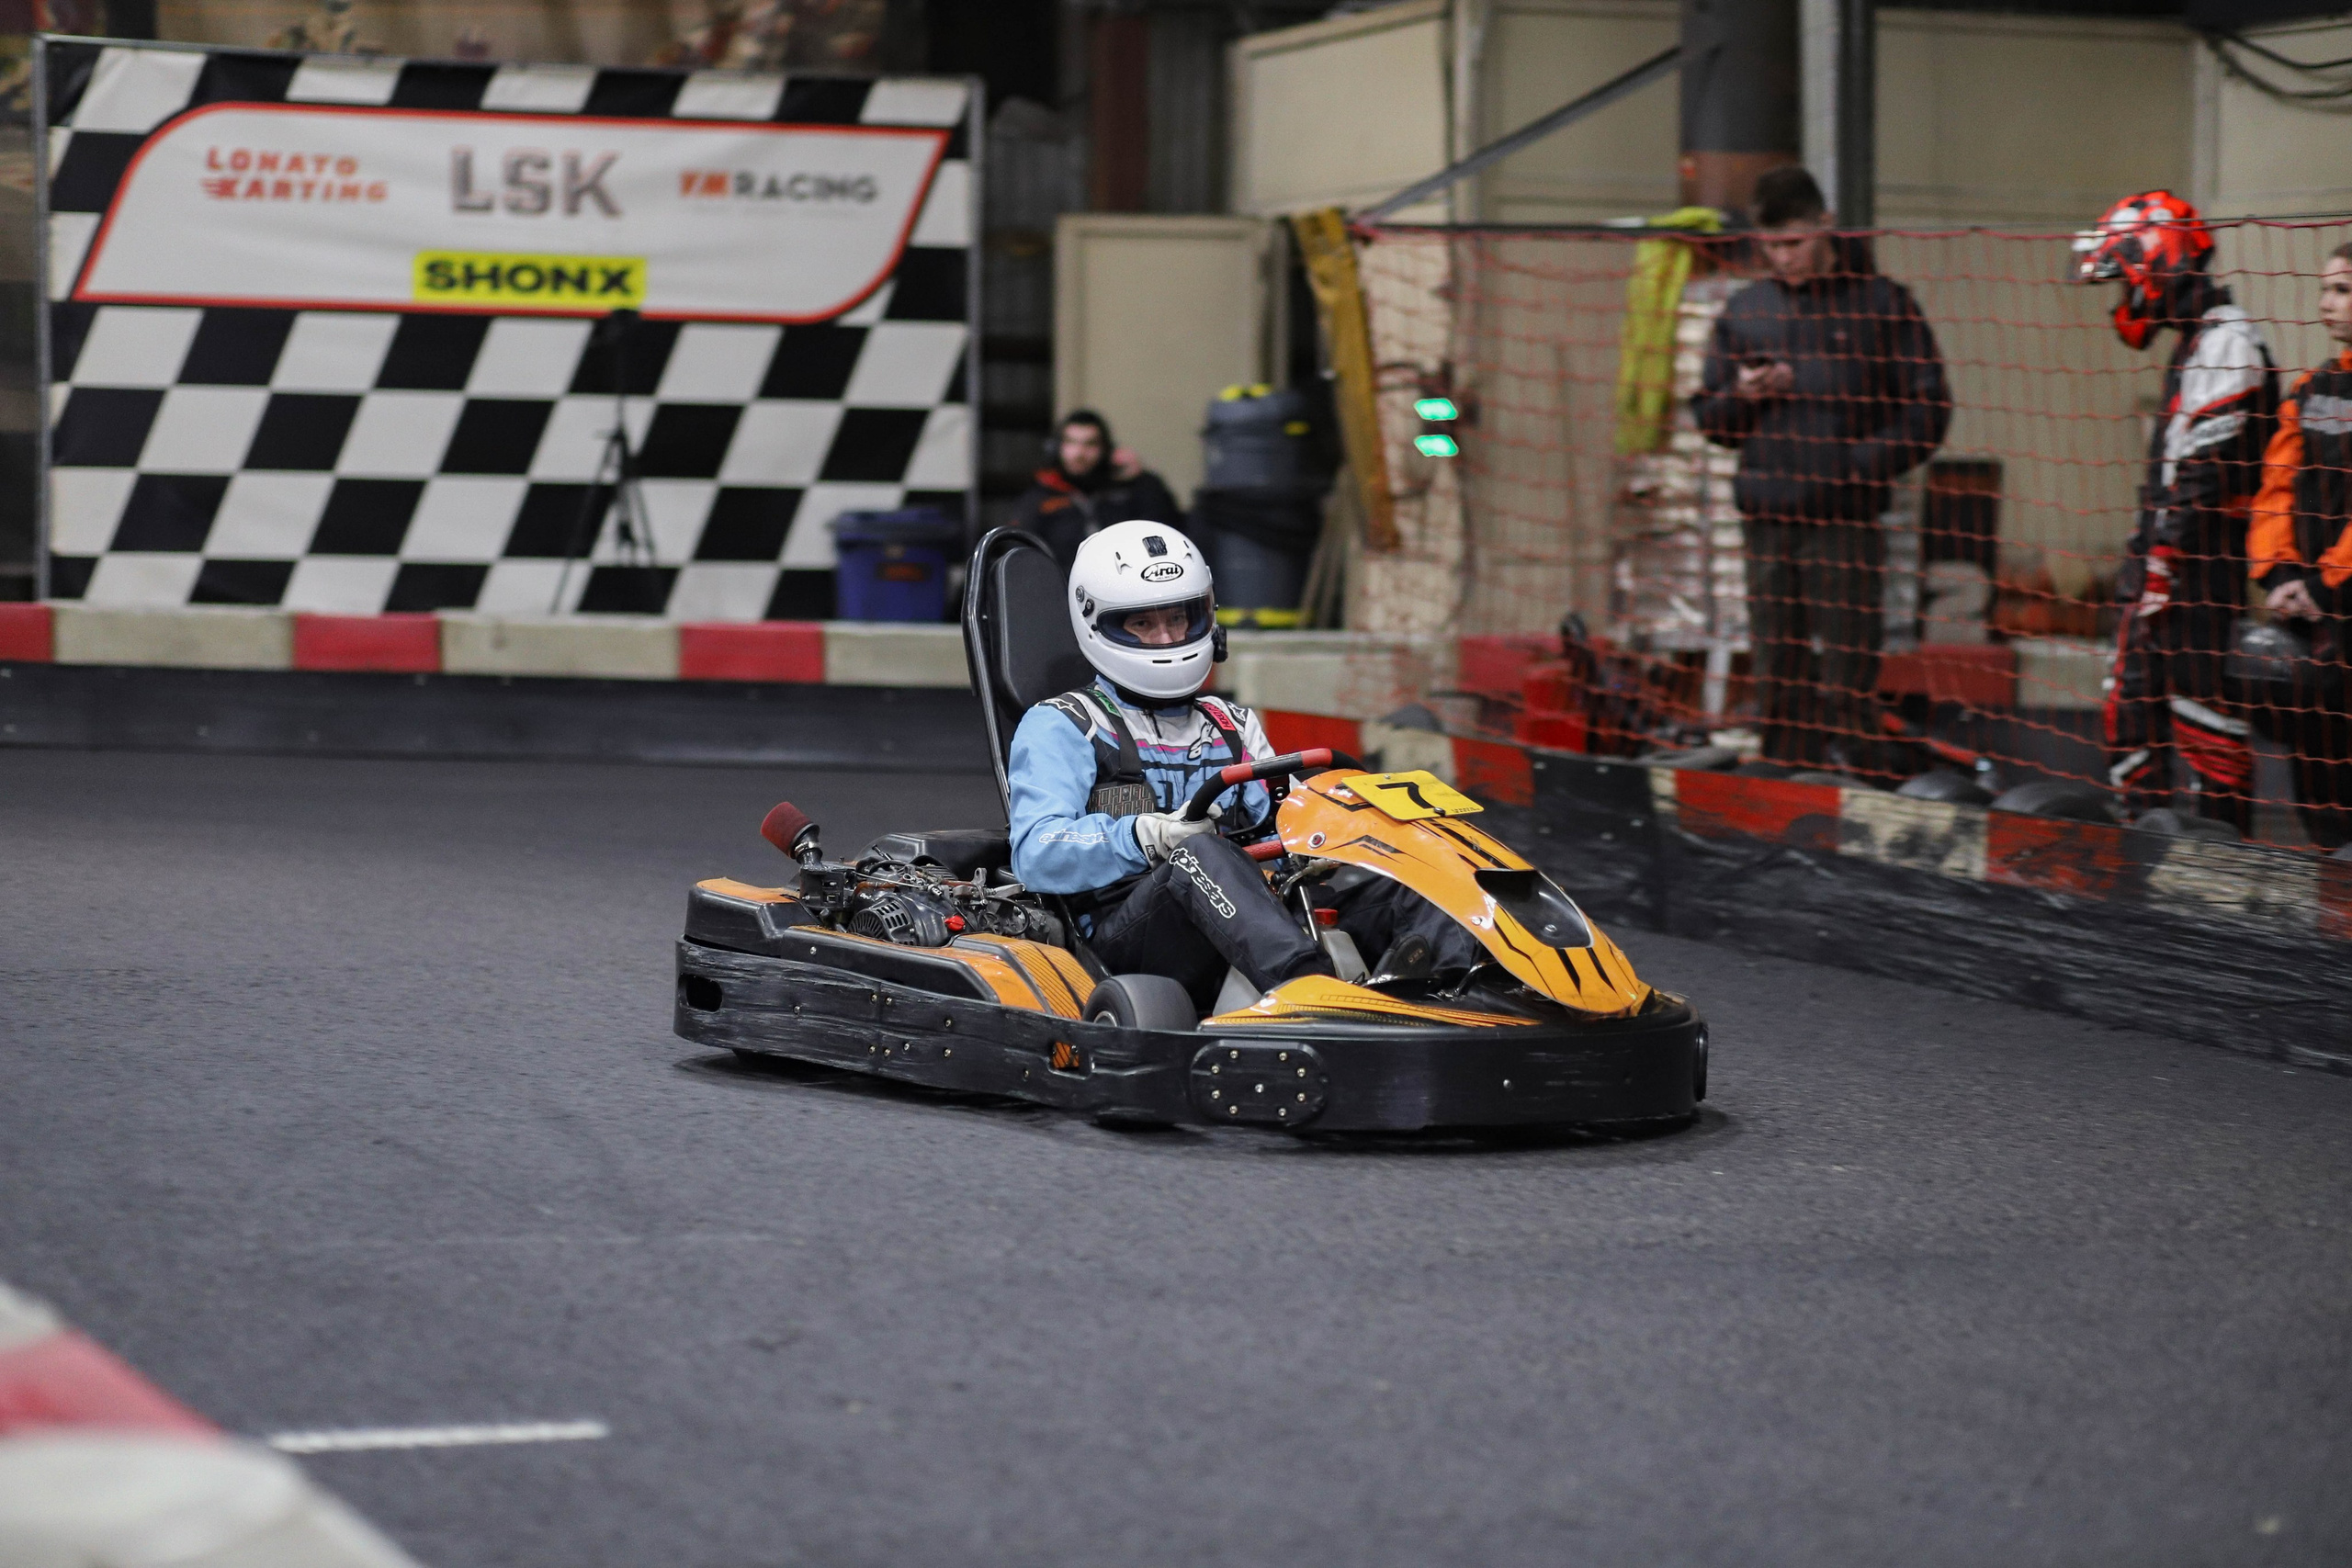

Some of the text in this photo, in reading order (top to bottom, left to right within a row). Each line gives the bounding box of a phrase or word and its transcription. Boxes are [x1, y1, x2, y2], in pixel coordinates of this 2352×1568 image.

[206, 145, 358, 176] LONATO
[201, 177, 389, 202] KARTING
[451, 146, 623, 219] LSK
[734, 170, 878, 203] RACING
[424, 260, 634, 296] SHONX
[1145, 564, 1180, 579] Arai
[1374, 781, 1436, 809] 7
